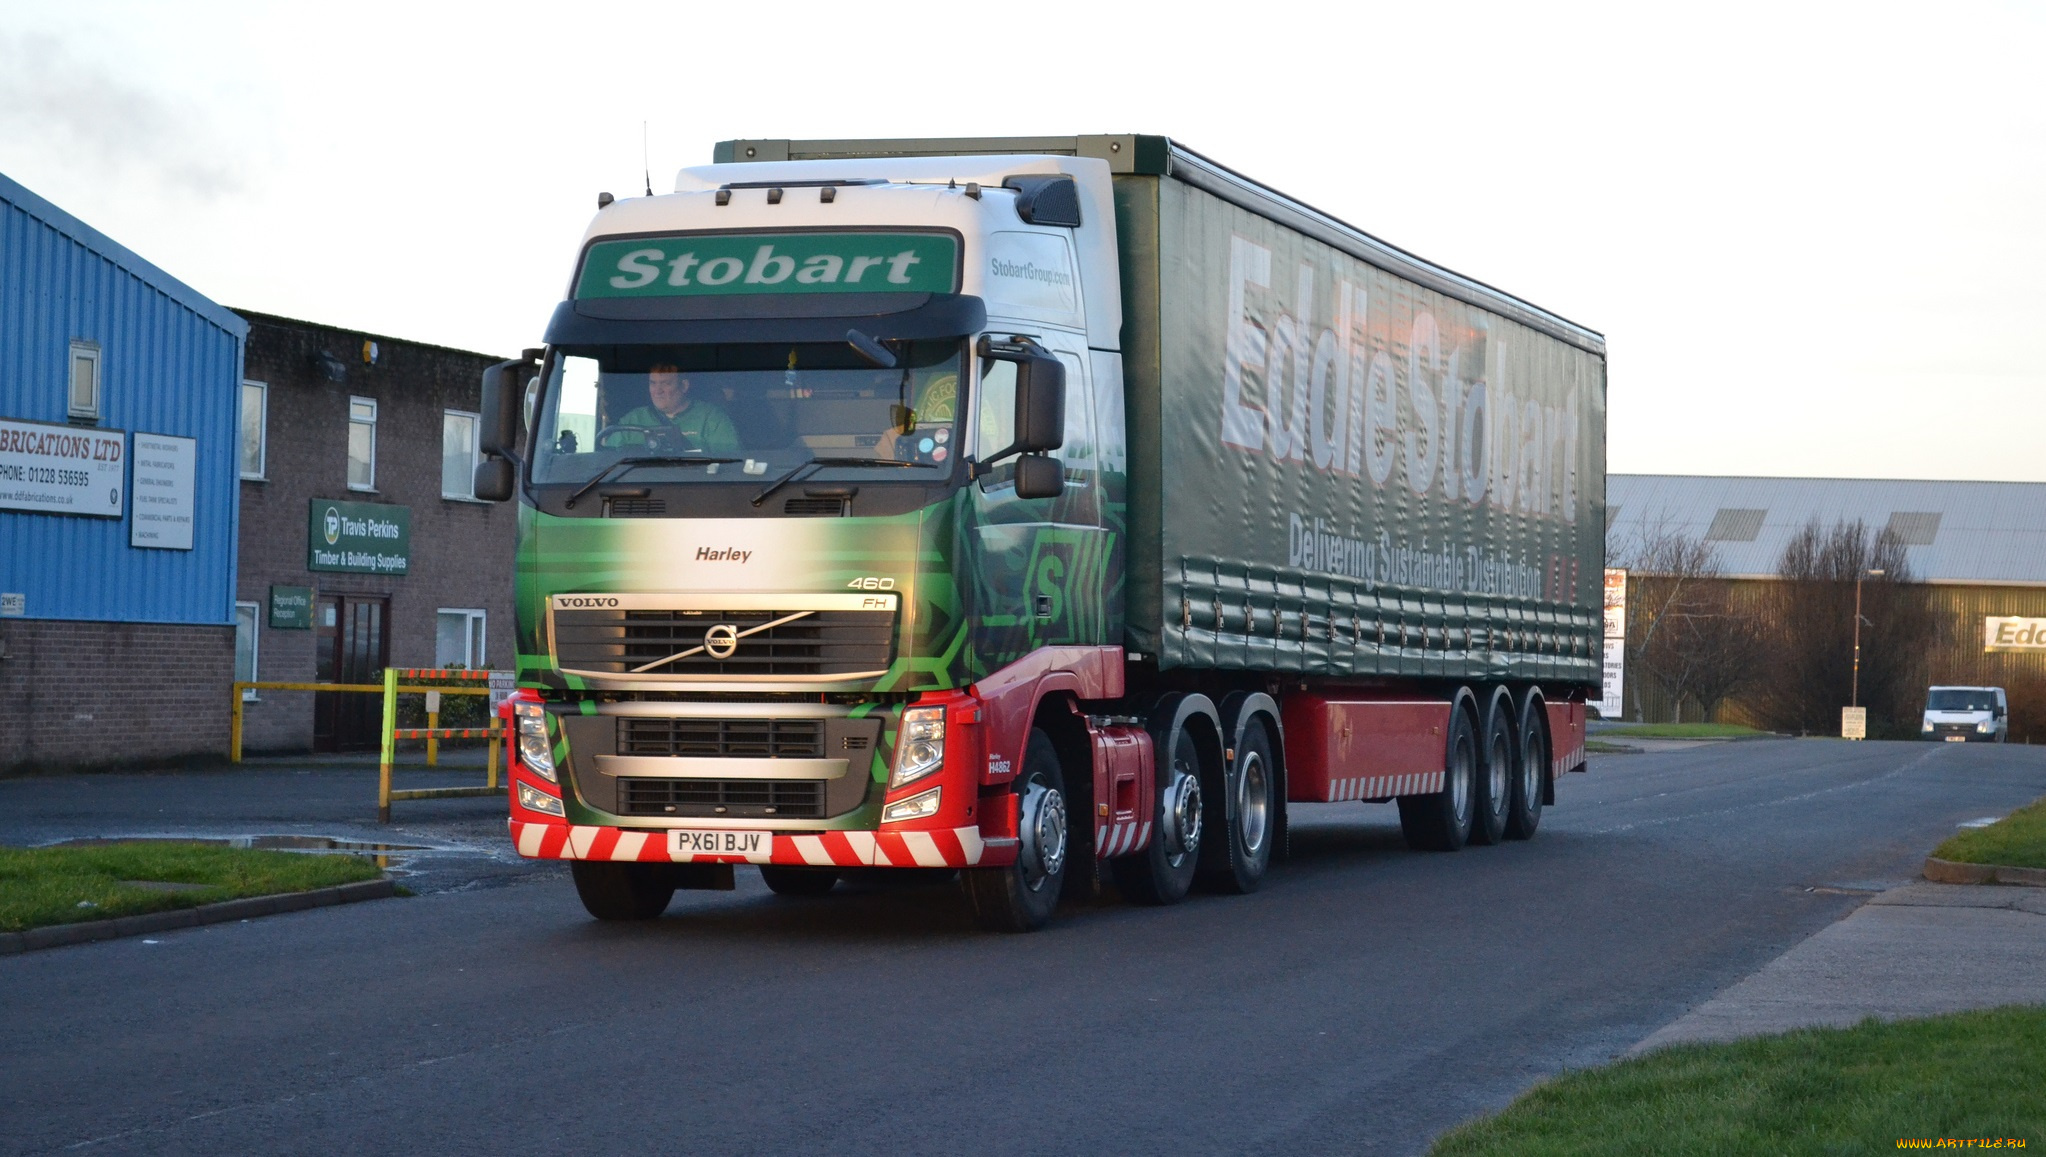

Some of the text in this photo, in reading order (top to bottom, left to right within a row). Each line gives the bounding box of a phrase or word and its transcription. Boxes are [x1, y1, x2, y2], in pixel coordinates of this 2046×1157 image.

[609, 245, 921, 289] Stobart
[991, 257, 1071, 288] StobartGroup.com
[1221, 234, 1577, 523] Eddie Stobart
[0, 429, 121, 462] BRICATIONS LTD
[28, 466, 56, 484] 01228
[58, 469, 89, 487] 536595
[341, 516, 366, 537] Travis
[368, 519, 399, 539] Perkins
[315, 549, 406, 571] Timber & Building Supplies
[695, 547, 752, 564] Harley
[1289, 512, 1541, 598] Delivering Sustainable Distribution
[847, 577, 895, 590] 460
[558, 597, 887, 609] VOLVO FH
[679, 832, 760, 852] PX61 BJV
